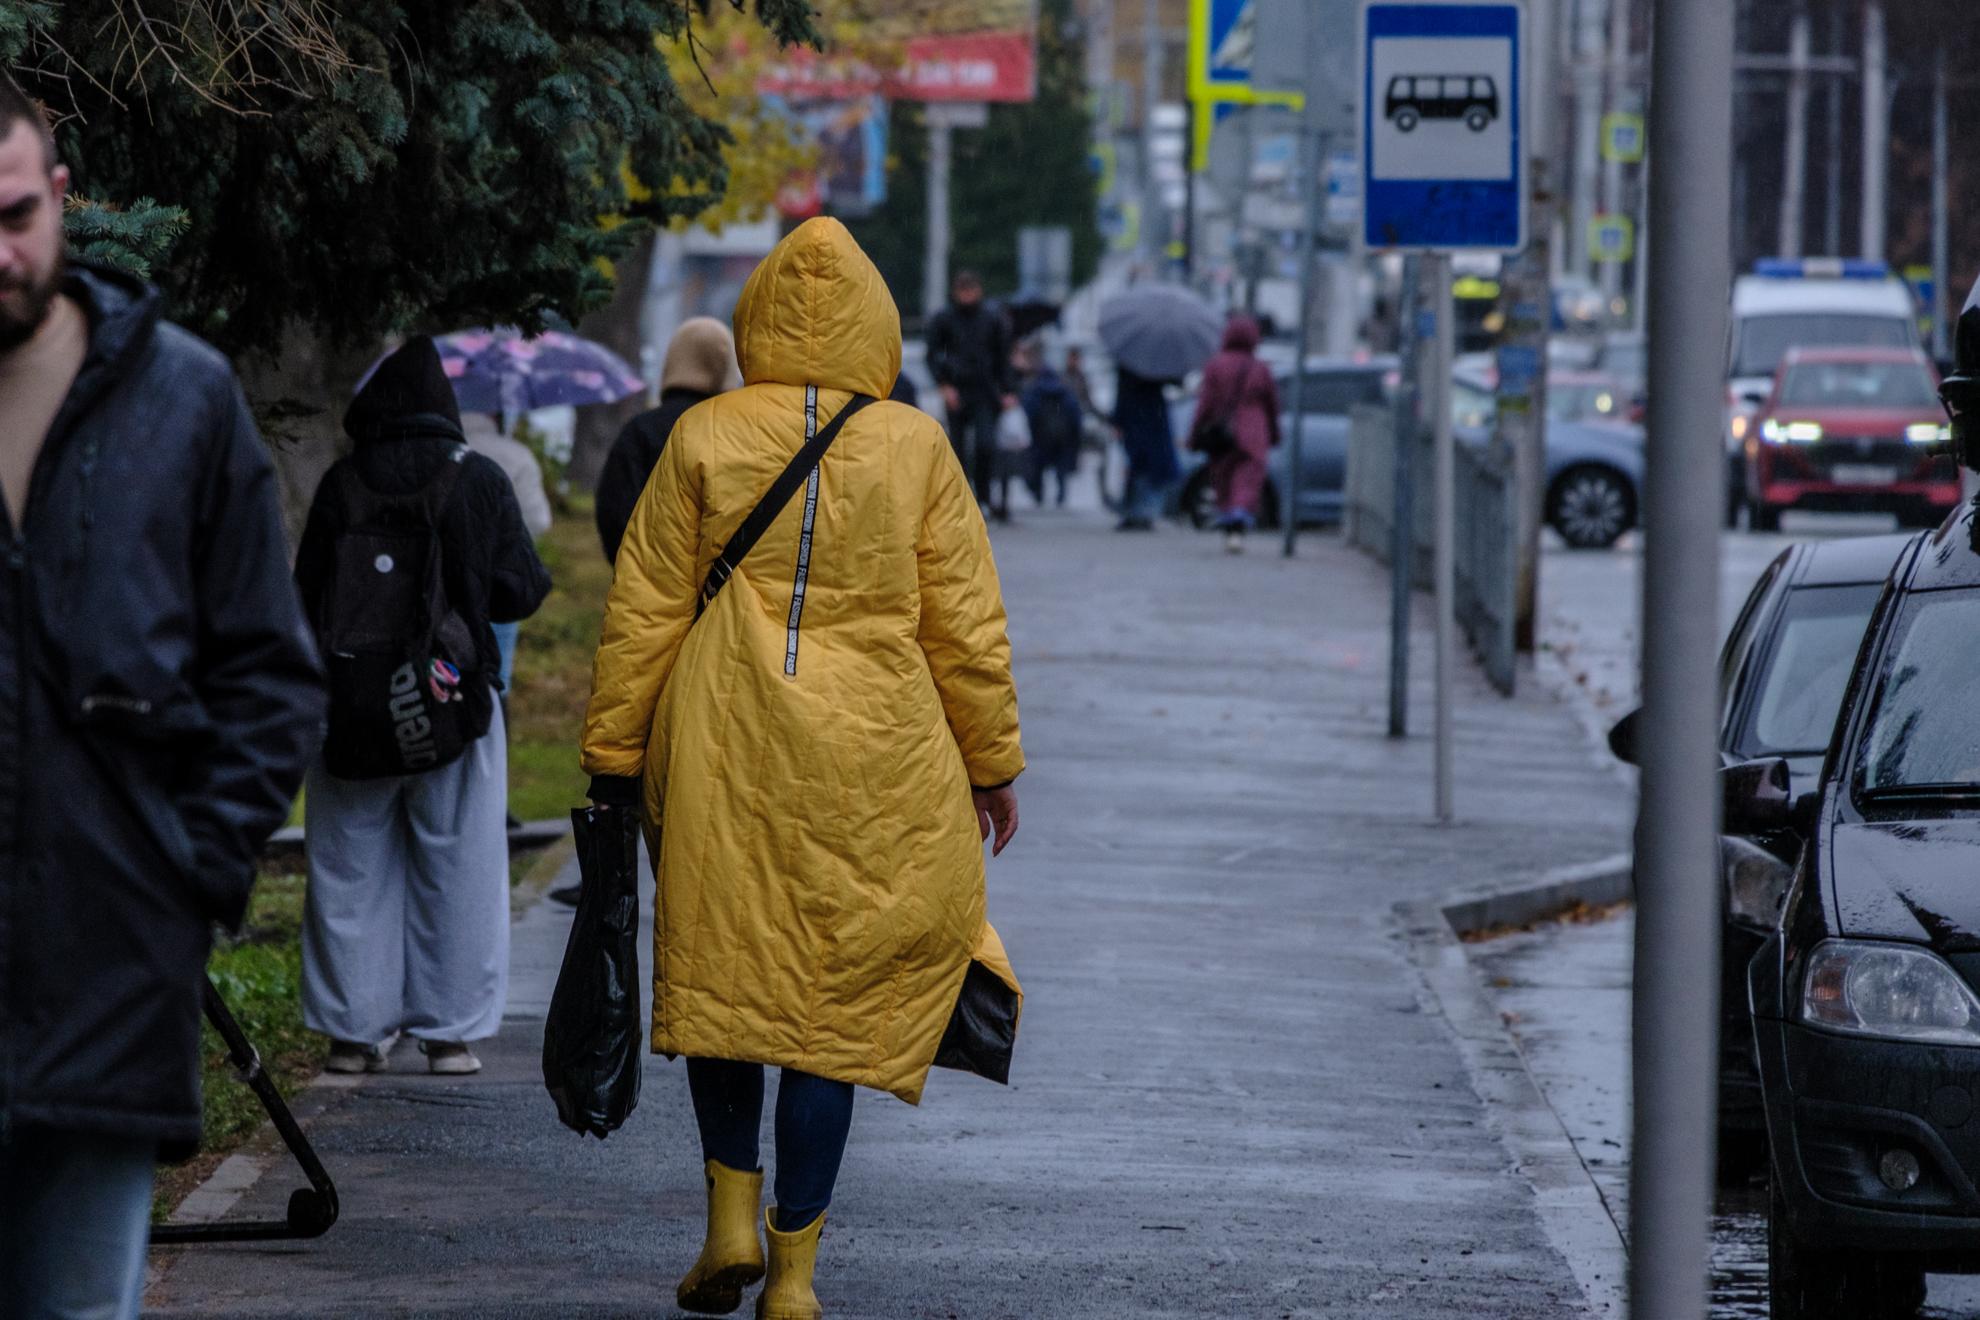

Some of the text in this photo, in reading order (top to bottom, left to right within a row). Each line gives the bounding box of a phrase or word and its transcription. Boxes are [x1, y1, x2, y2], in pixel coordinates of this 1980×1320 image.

[803, 500, 815, 532] FASHION
[799, 534, 811, 565] FASHION
[788, 597, 802, 627] FASHION
[389, 662, 438, 768] arena
